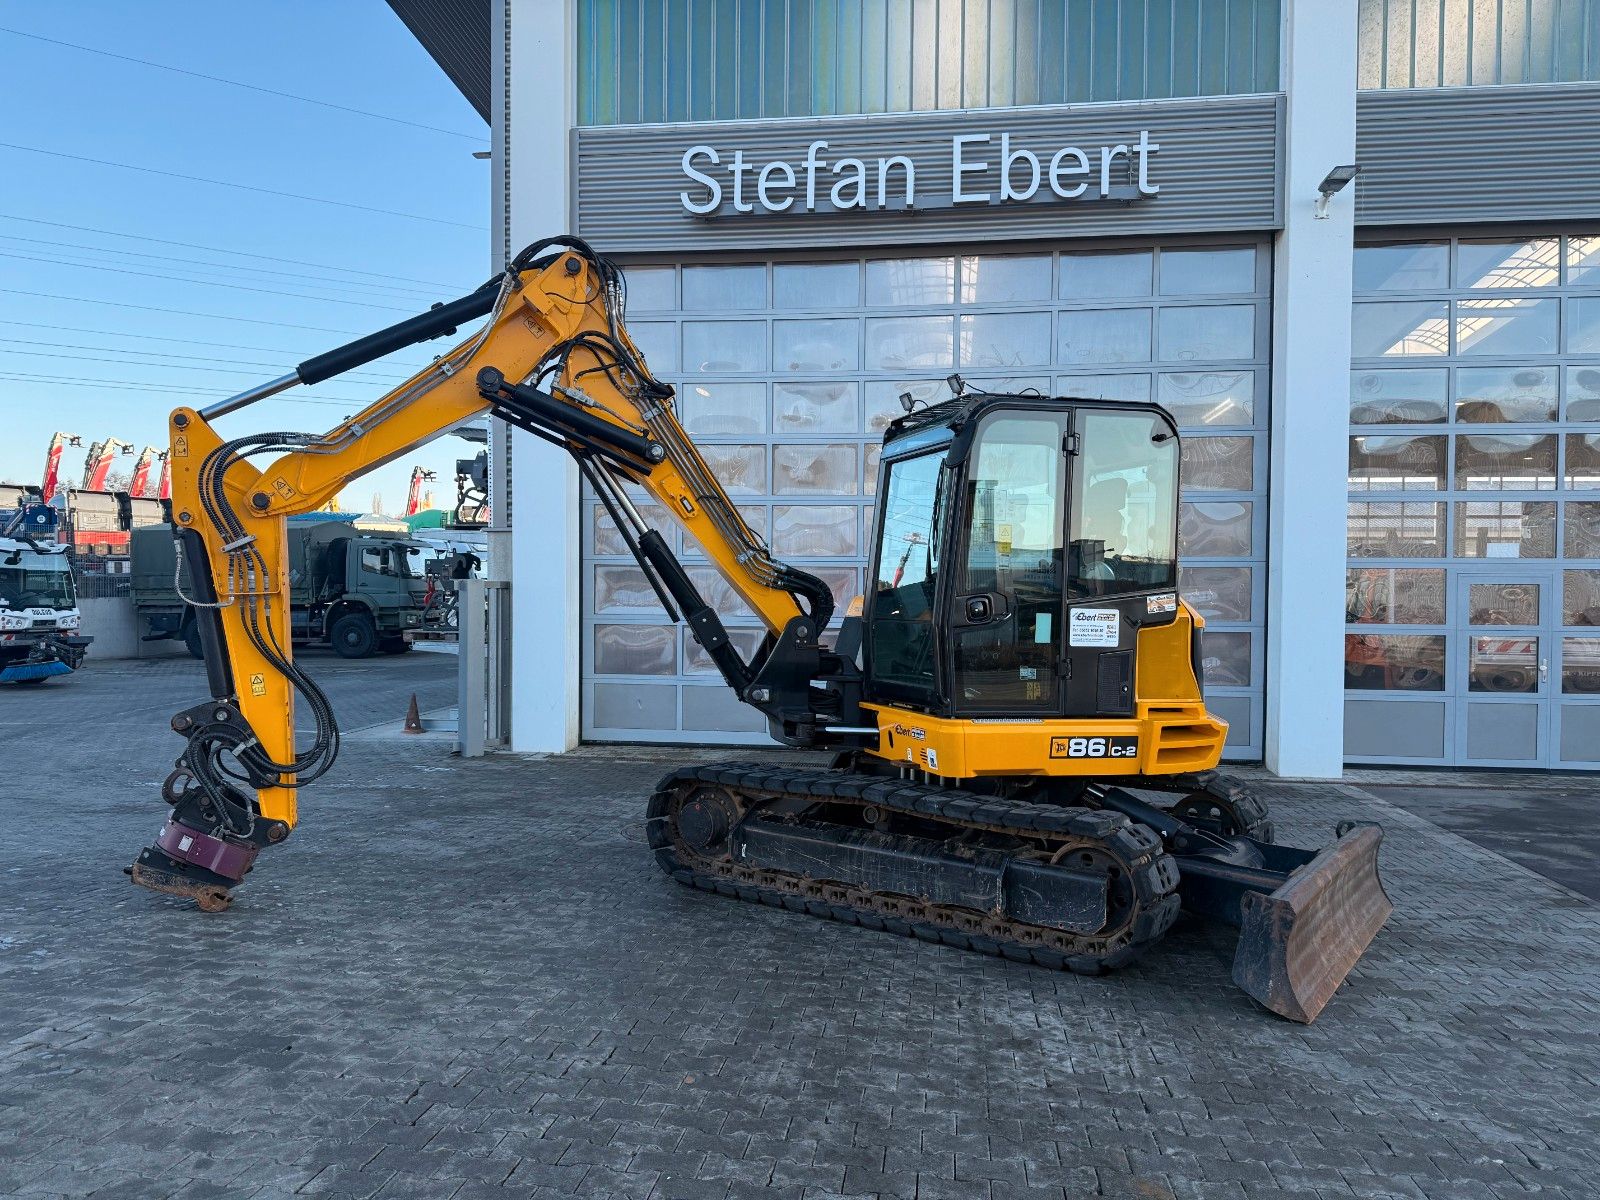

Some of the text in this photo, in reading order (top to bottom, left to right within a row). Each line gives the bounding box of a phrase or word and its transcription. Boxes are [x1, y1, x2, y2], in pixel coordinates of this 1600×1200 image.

[680, 130, 1160, 214] Stefan Ebert
[1076, 612, 1097, 622] Ebert
[1068, 737, 1106, 757] 86
[1111, 745, 1137, 757] C-2
